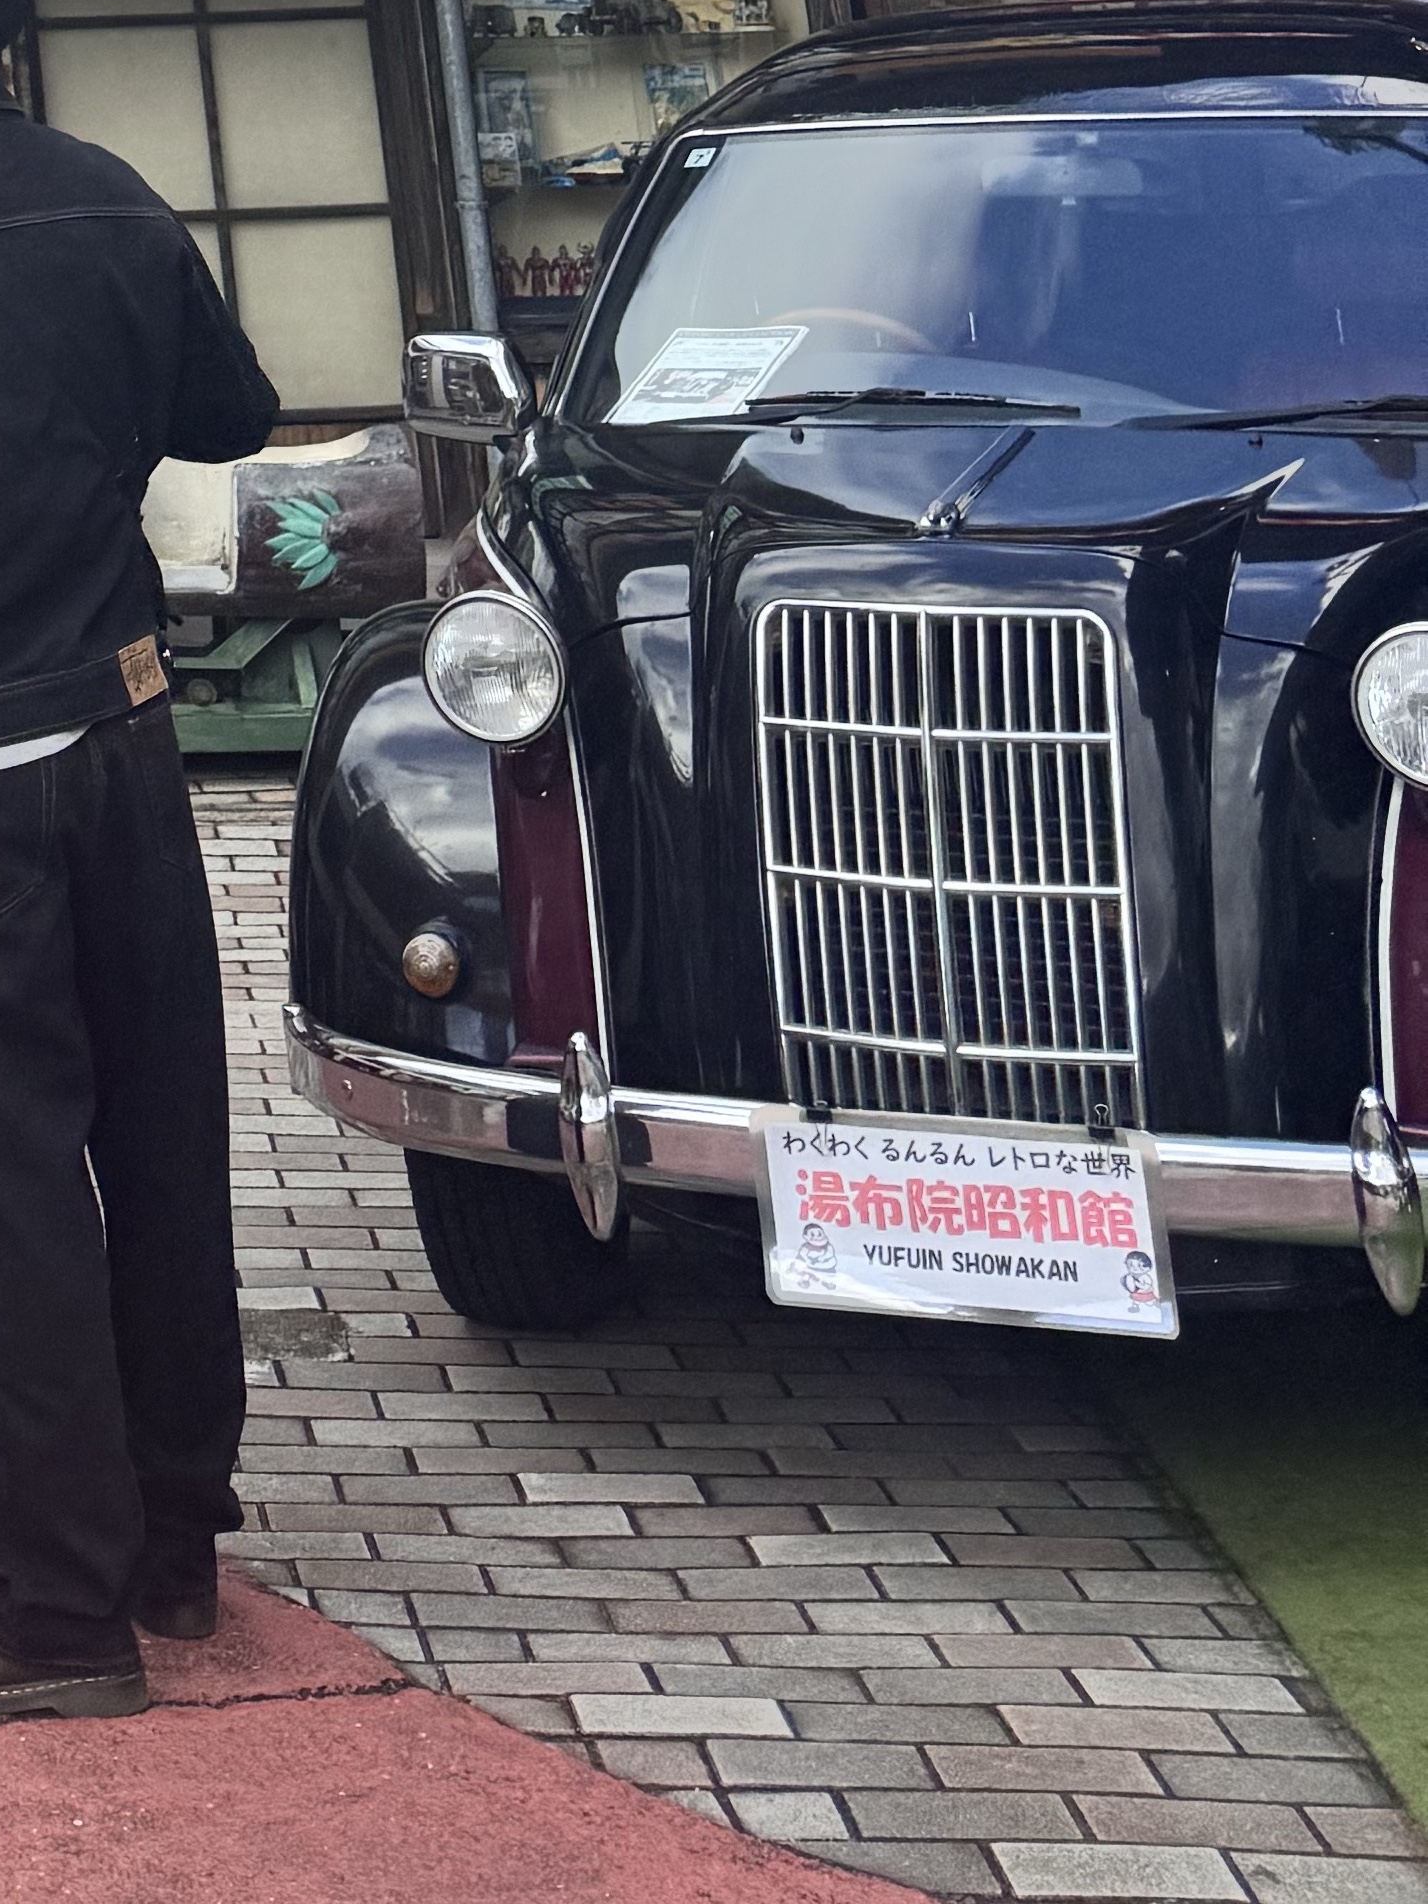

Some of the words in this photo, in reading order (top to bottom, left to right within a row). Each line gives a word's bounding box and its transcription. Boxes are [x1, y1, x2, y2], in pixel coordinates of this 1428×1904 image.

[783, 1131, 869, 1160] わくわく
[882, 1137, 976, 1167] るんるん
[989, 1146, 1137, 1181] レトロな世界
[795, 1168, 1139, 1250] 湯布院昭和館
[863, 1244, 944, 1272] YUFUIN
[952, 1251, 1079, 1283] SHOWAKAN
